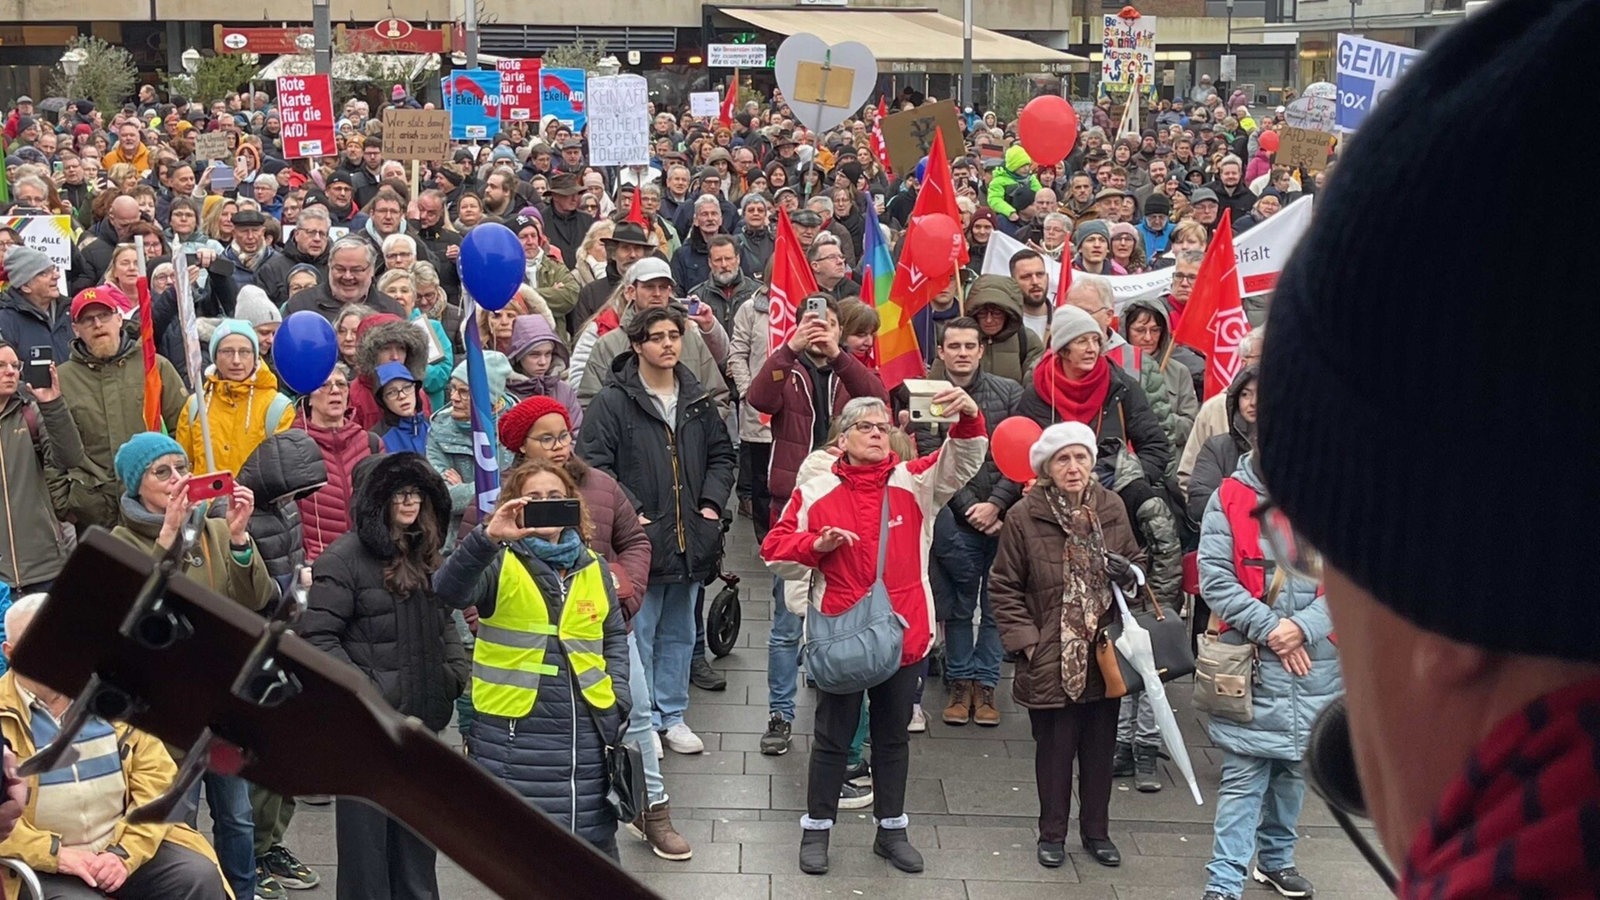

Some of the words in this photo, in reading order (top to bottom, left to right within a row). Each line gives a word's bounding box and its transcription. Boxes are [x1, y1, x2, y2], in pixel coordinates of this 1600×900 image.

[280, 78, 306, 91] Rote
[516, 82, 532, 94] die
[281, 93, 312, 107] Karte
[283, 107, 300, 122] für
[303, 106, 321, 121] die
[285, 123, 308, 138] AfD!
[591, 117, 643, 132] FREIHEIT
[591, 132, 646, 147] RESPEKT
[592, 147, 648, 161] TOLERANZ
[41, 236, 61, 244] ALLE
